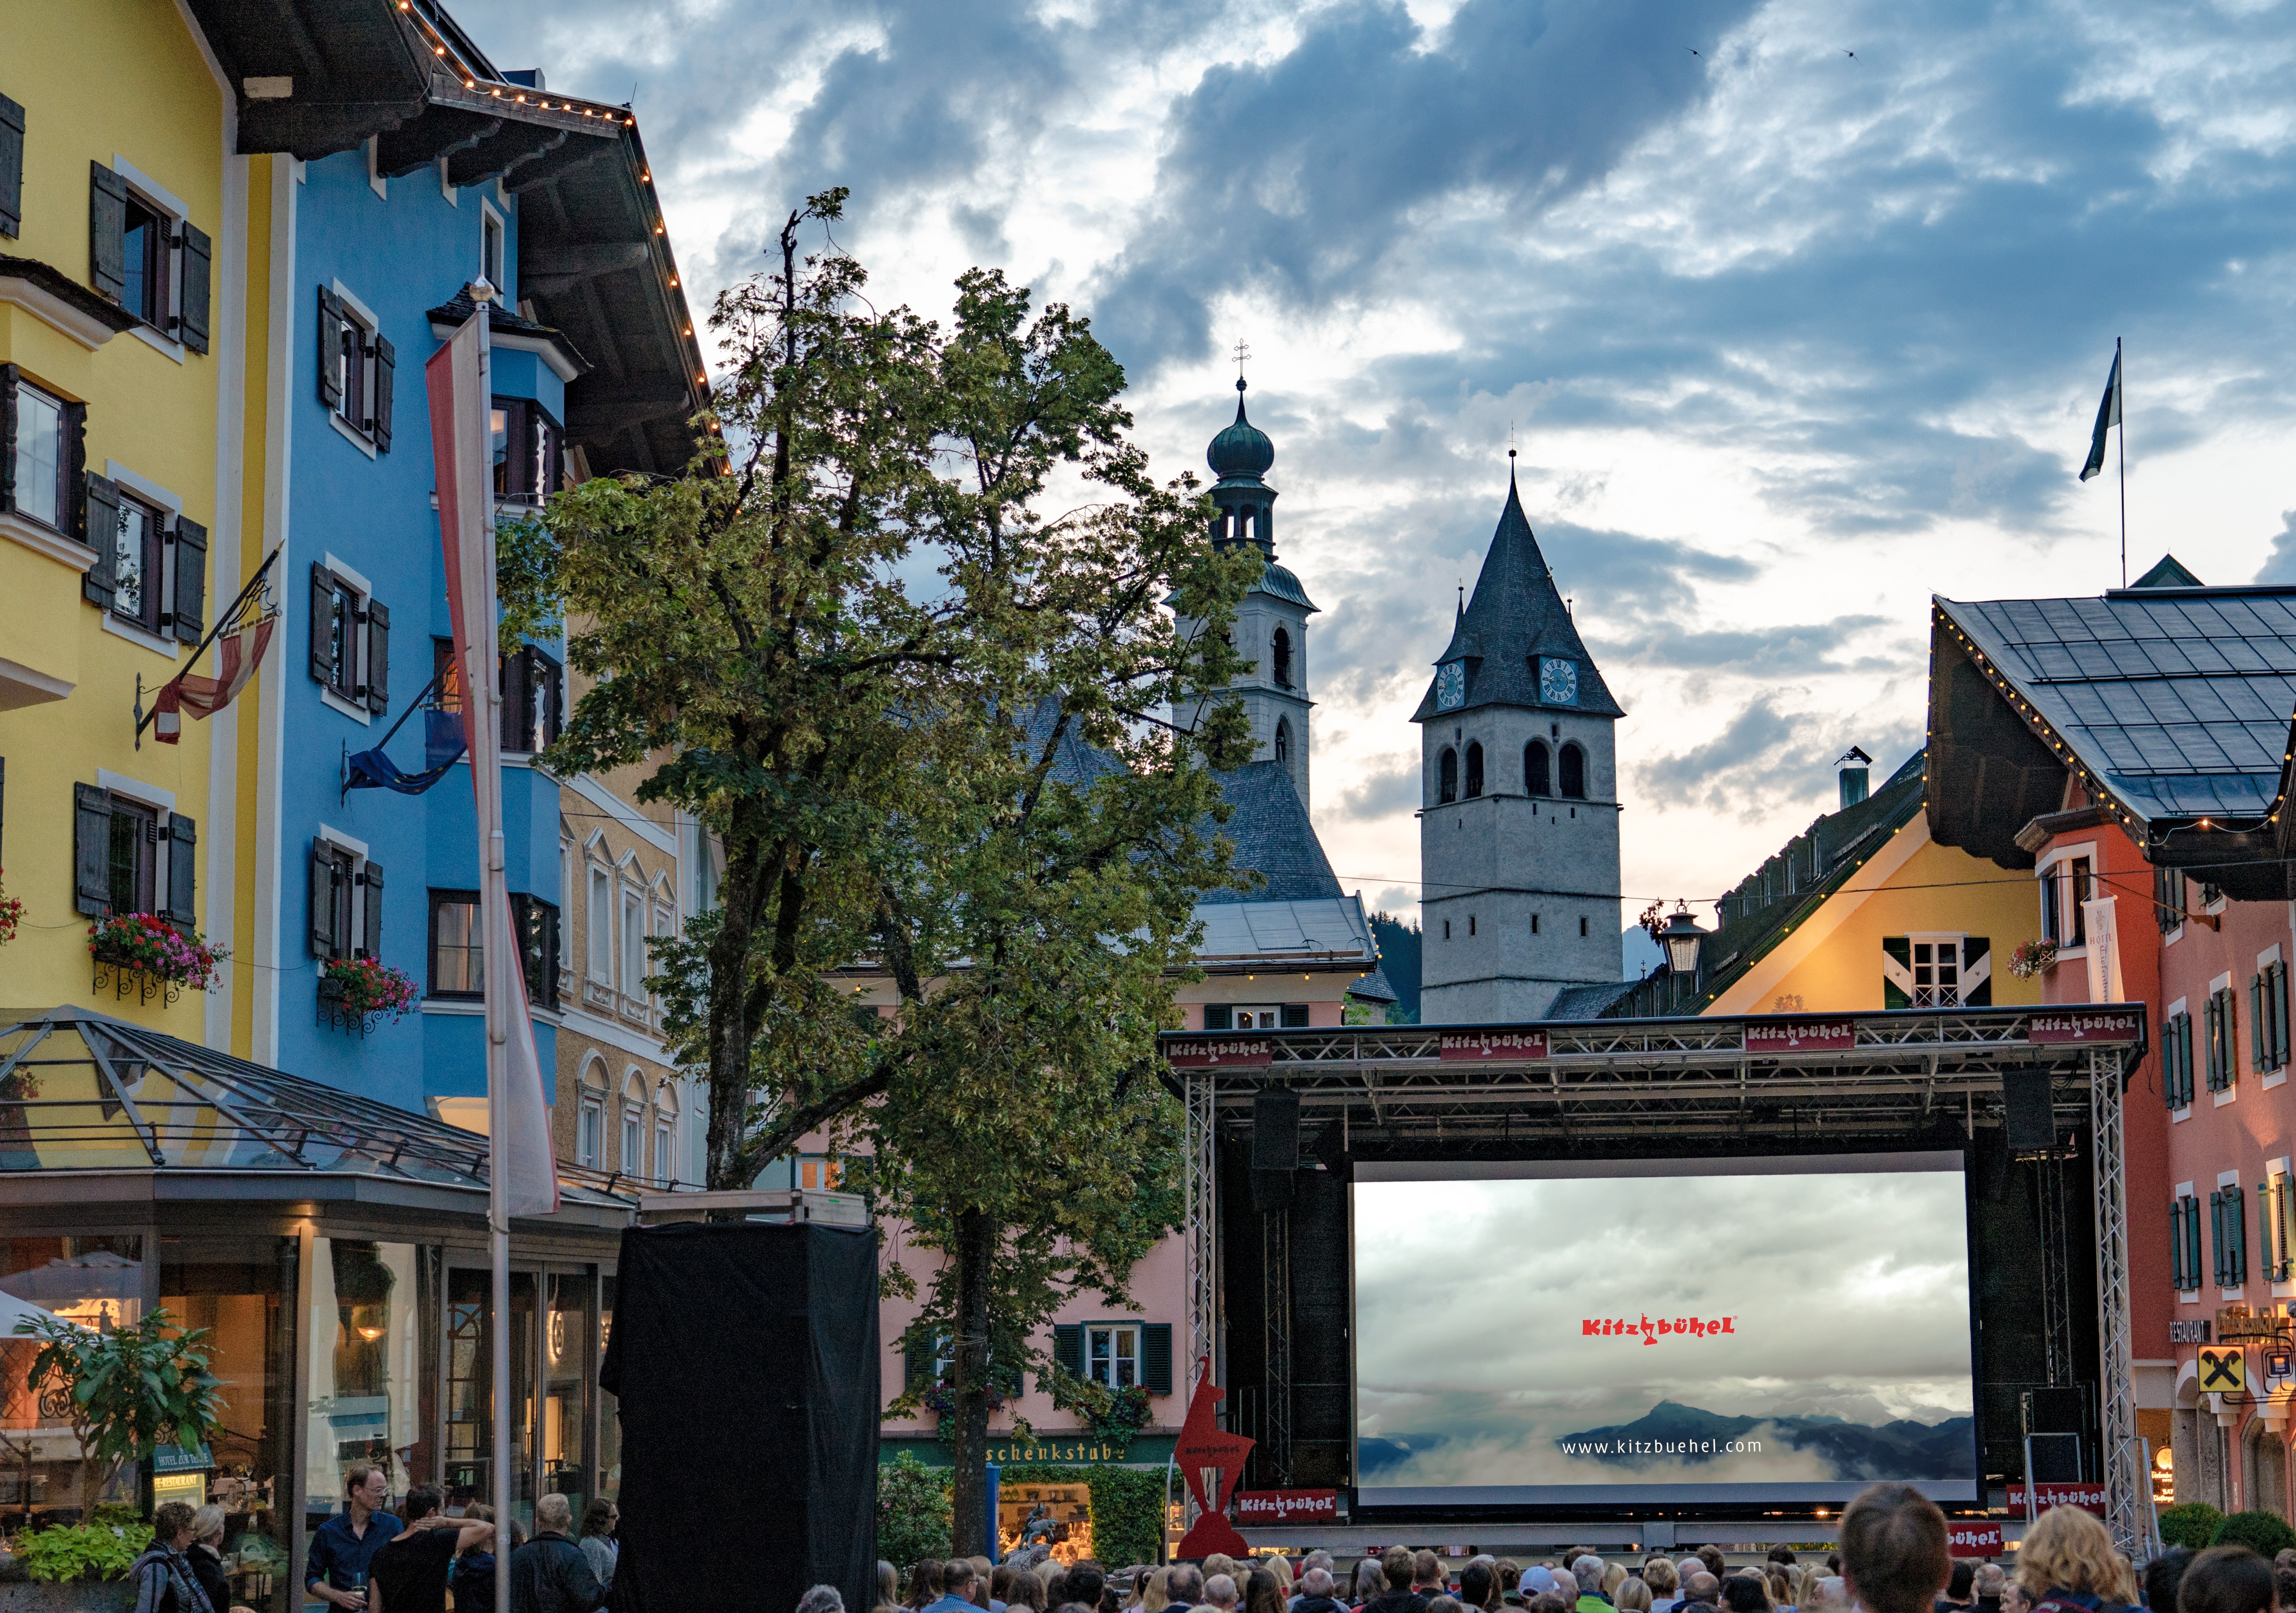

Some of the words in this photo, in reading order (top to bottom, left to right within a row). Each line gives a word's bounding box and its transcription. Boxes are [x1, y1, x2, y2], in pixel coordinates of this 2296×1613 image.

[2090, 933, 2113, 945] HOTEL
[2099, 945, 2108, 1003] Tiefenbru
[2169, 1321, 2204, 1342] RESTAURANT
[985, 1443, 1124, 1461] schenkstube
[1562, 1439, 1762, 1454] www.kitzbuehel.com
[158, 1455, 177, 1466] HOTEL
[178, 1454, 190, 1464] ZUR
[189, 1453, 209, 1464] TEE
[154, 1475, 197, 1488] FE-RESTAURANT
